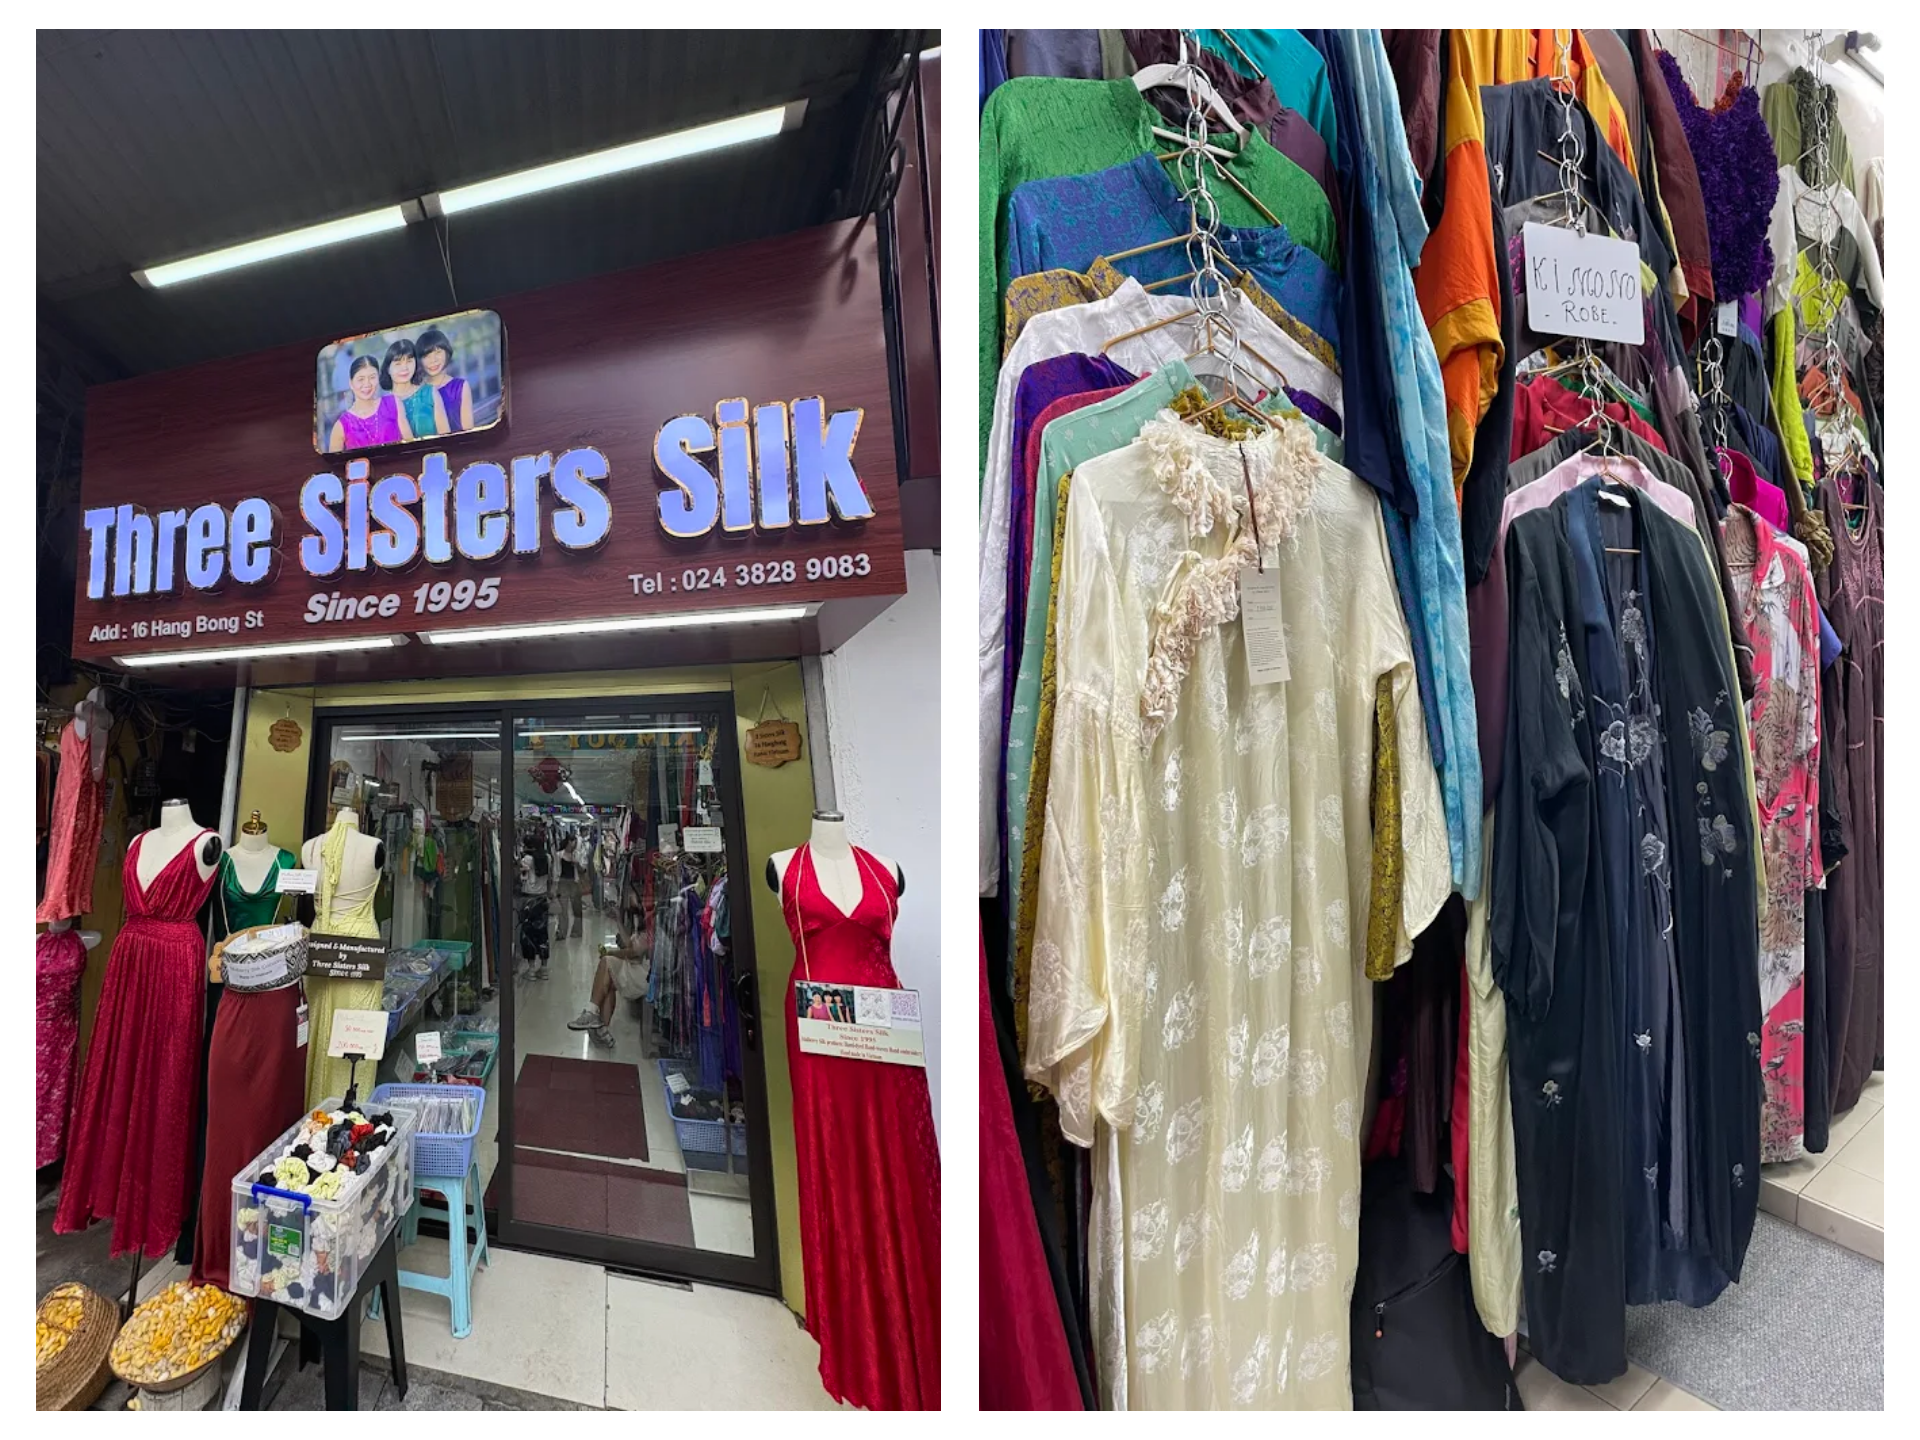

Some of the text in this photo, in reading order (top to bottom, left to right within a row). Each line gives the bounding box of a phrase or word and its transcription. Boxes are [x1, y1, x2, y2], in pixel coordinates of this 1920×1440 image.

[85, 395, 876, 599] Three Sisters Silk
[682, 567, 727, 591] 024
[735, 560, 797, 587] 3828
[805, 553, 872, 581] 9083
[303, 577, 502, 624] Since 1995
[131, 621, 148, 638] 16
[151, 620, 192, 638] Hang
[195, 615, 240, 634] Bong
[244, 610, 264, 629] St
[338, 951, 348, 961] by
[339, 943, 385, 954] Manufactured
[312, 960, 370, 971] Three Sisters Silk
[827, 1023, 889, 1037] Three Sisters Silk
